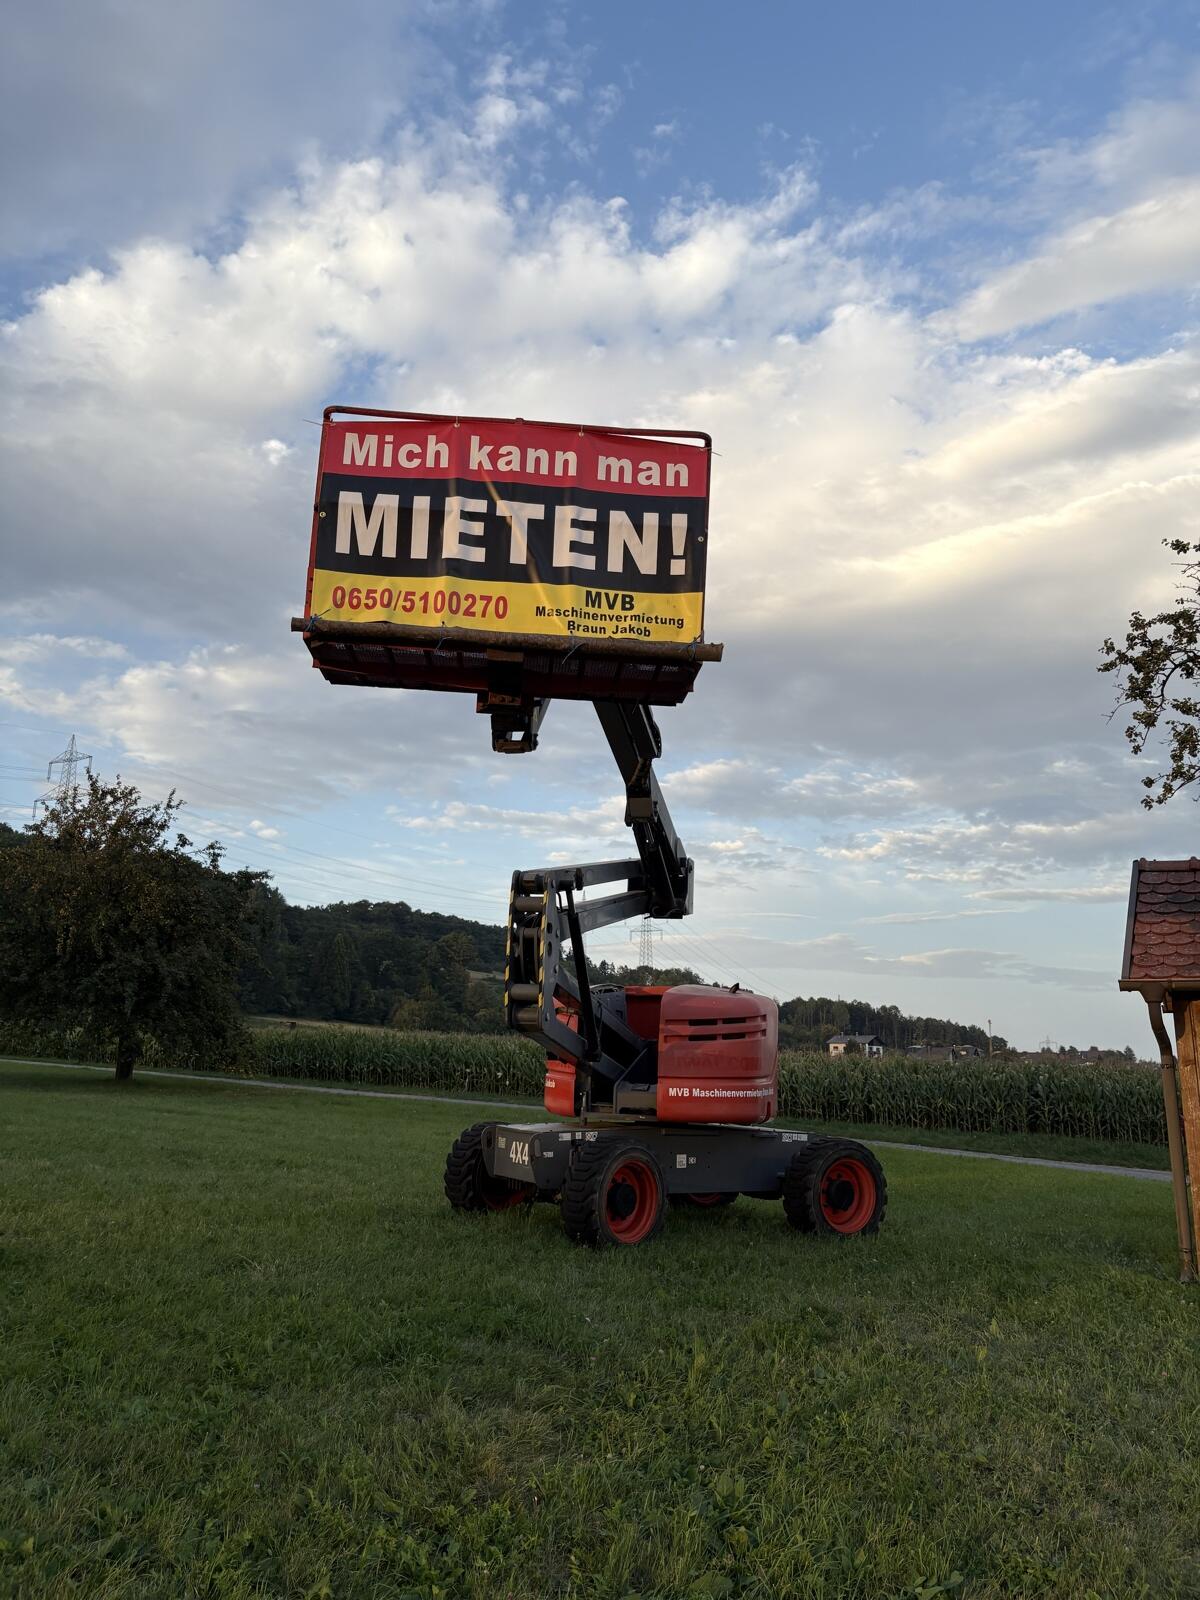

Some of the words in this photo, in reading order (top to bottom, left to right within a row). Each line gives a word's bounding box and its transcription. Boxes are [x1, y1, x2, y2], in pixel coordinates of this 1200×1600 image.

[342, 432, 449, 468] Mich
[469, 435, 577, 476] kann
[596, 454, 689, 487] man
[335, 490, 688, 576] MIETEN!
[331, 586, 509, 619] 0650/5100270
[585, 590, 635, 611] MVB
[535, 605, 685, 629] Maschinenvermietung
[567, 620, 606, 635] Braun
[612, 624, 651, 638] Jakob
[668, 1087, 690, 1097] MVB
[509, 1141, 529, 1165] 4X4
